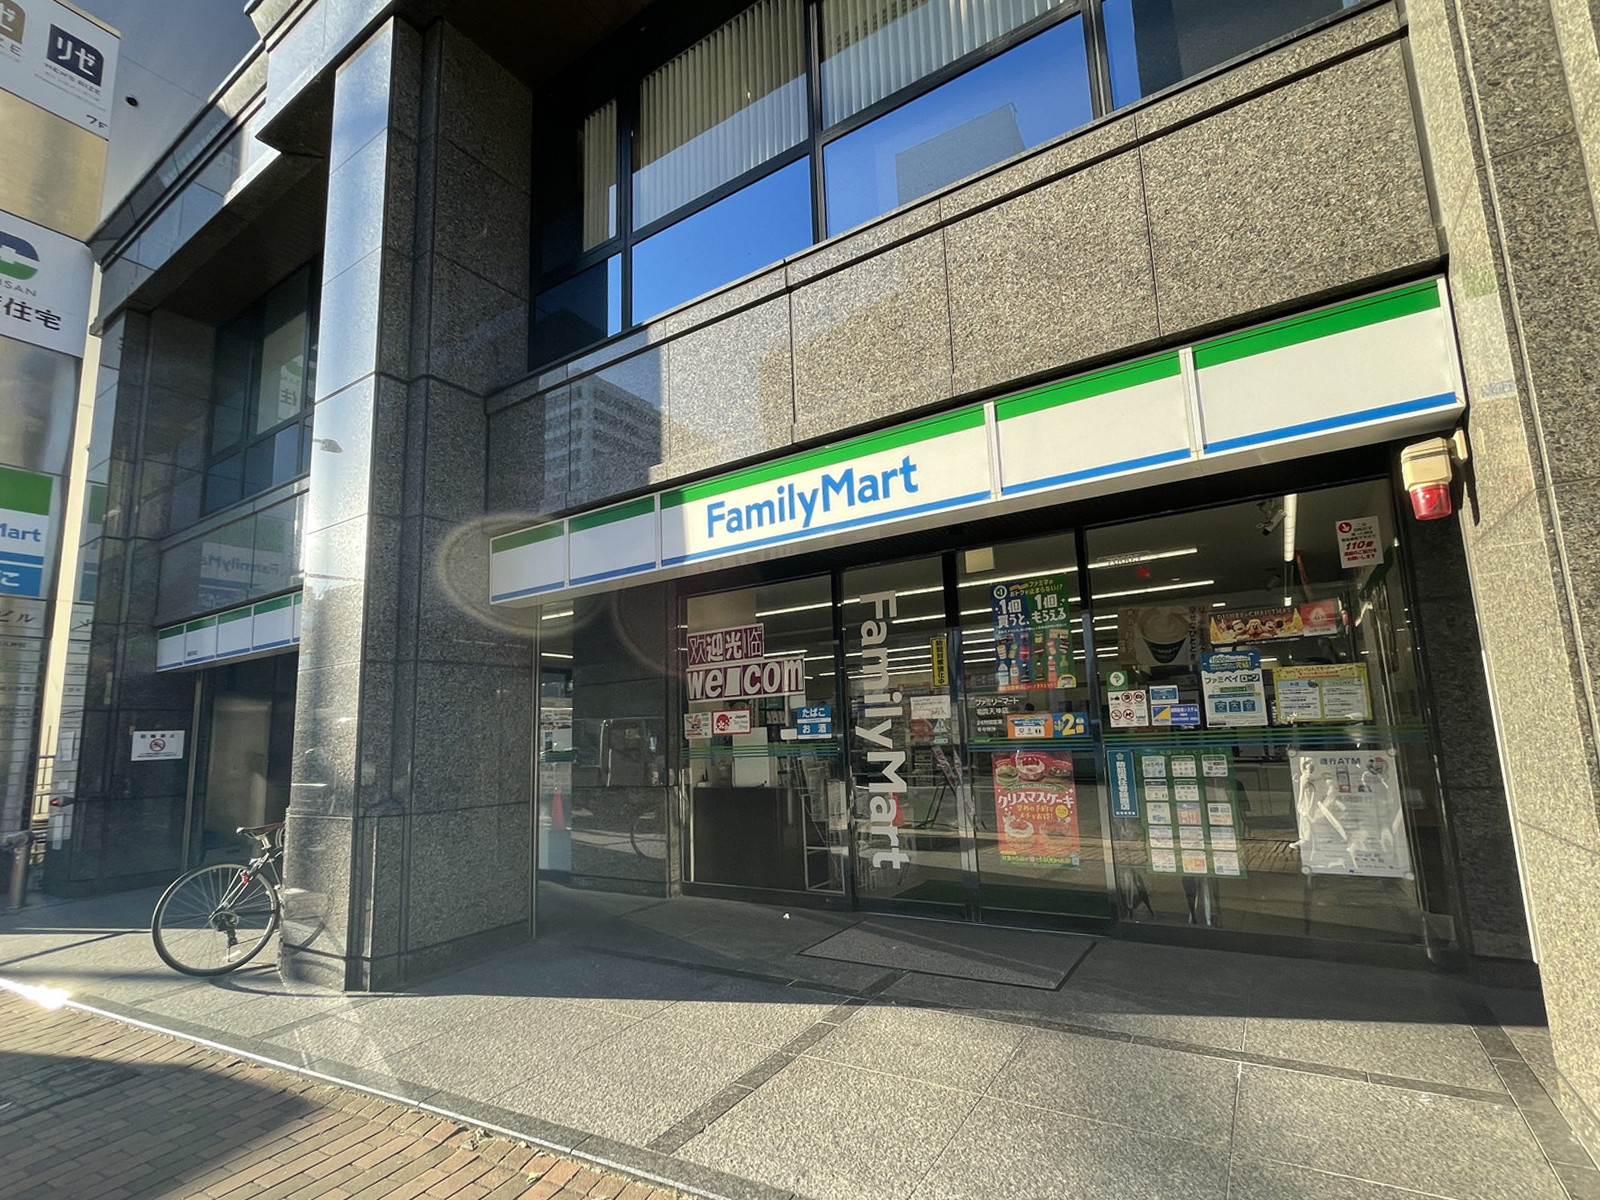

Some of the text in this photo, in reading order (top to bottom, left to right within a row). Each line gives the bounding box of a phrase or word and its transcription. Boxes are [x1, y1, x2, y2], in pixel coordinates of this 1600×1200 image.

[57, 36, 97, 77] リゼ
[86, 114, 108, 128] 7F
[0, 279, 37, 297] SAN
[0, 296, 61, 331] 住宅
[706, 455, 919, 538] FamilyMart
[1032, 608, 1067, 624] もらえる
[689, 627, 762, 664] 欢迎光临
[687, 658, 804, 700] wecom
[802, 707, 826, 718] たばこ
[975, 697, 1020, 706] ファミリーマート
[855, 590, 909, 869] FamilyMart
[998, 791, 1074, 808] クリスマスケーキ
